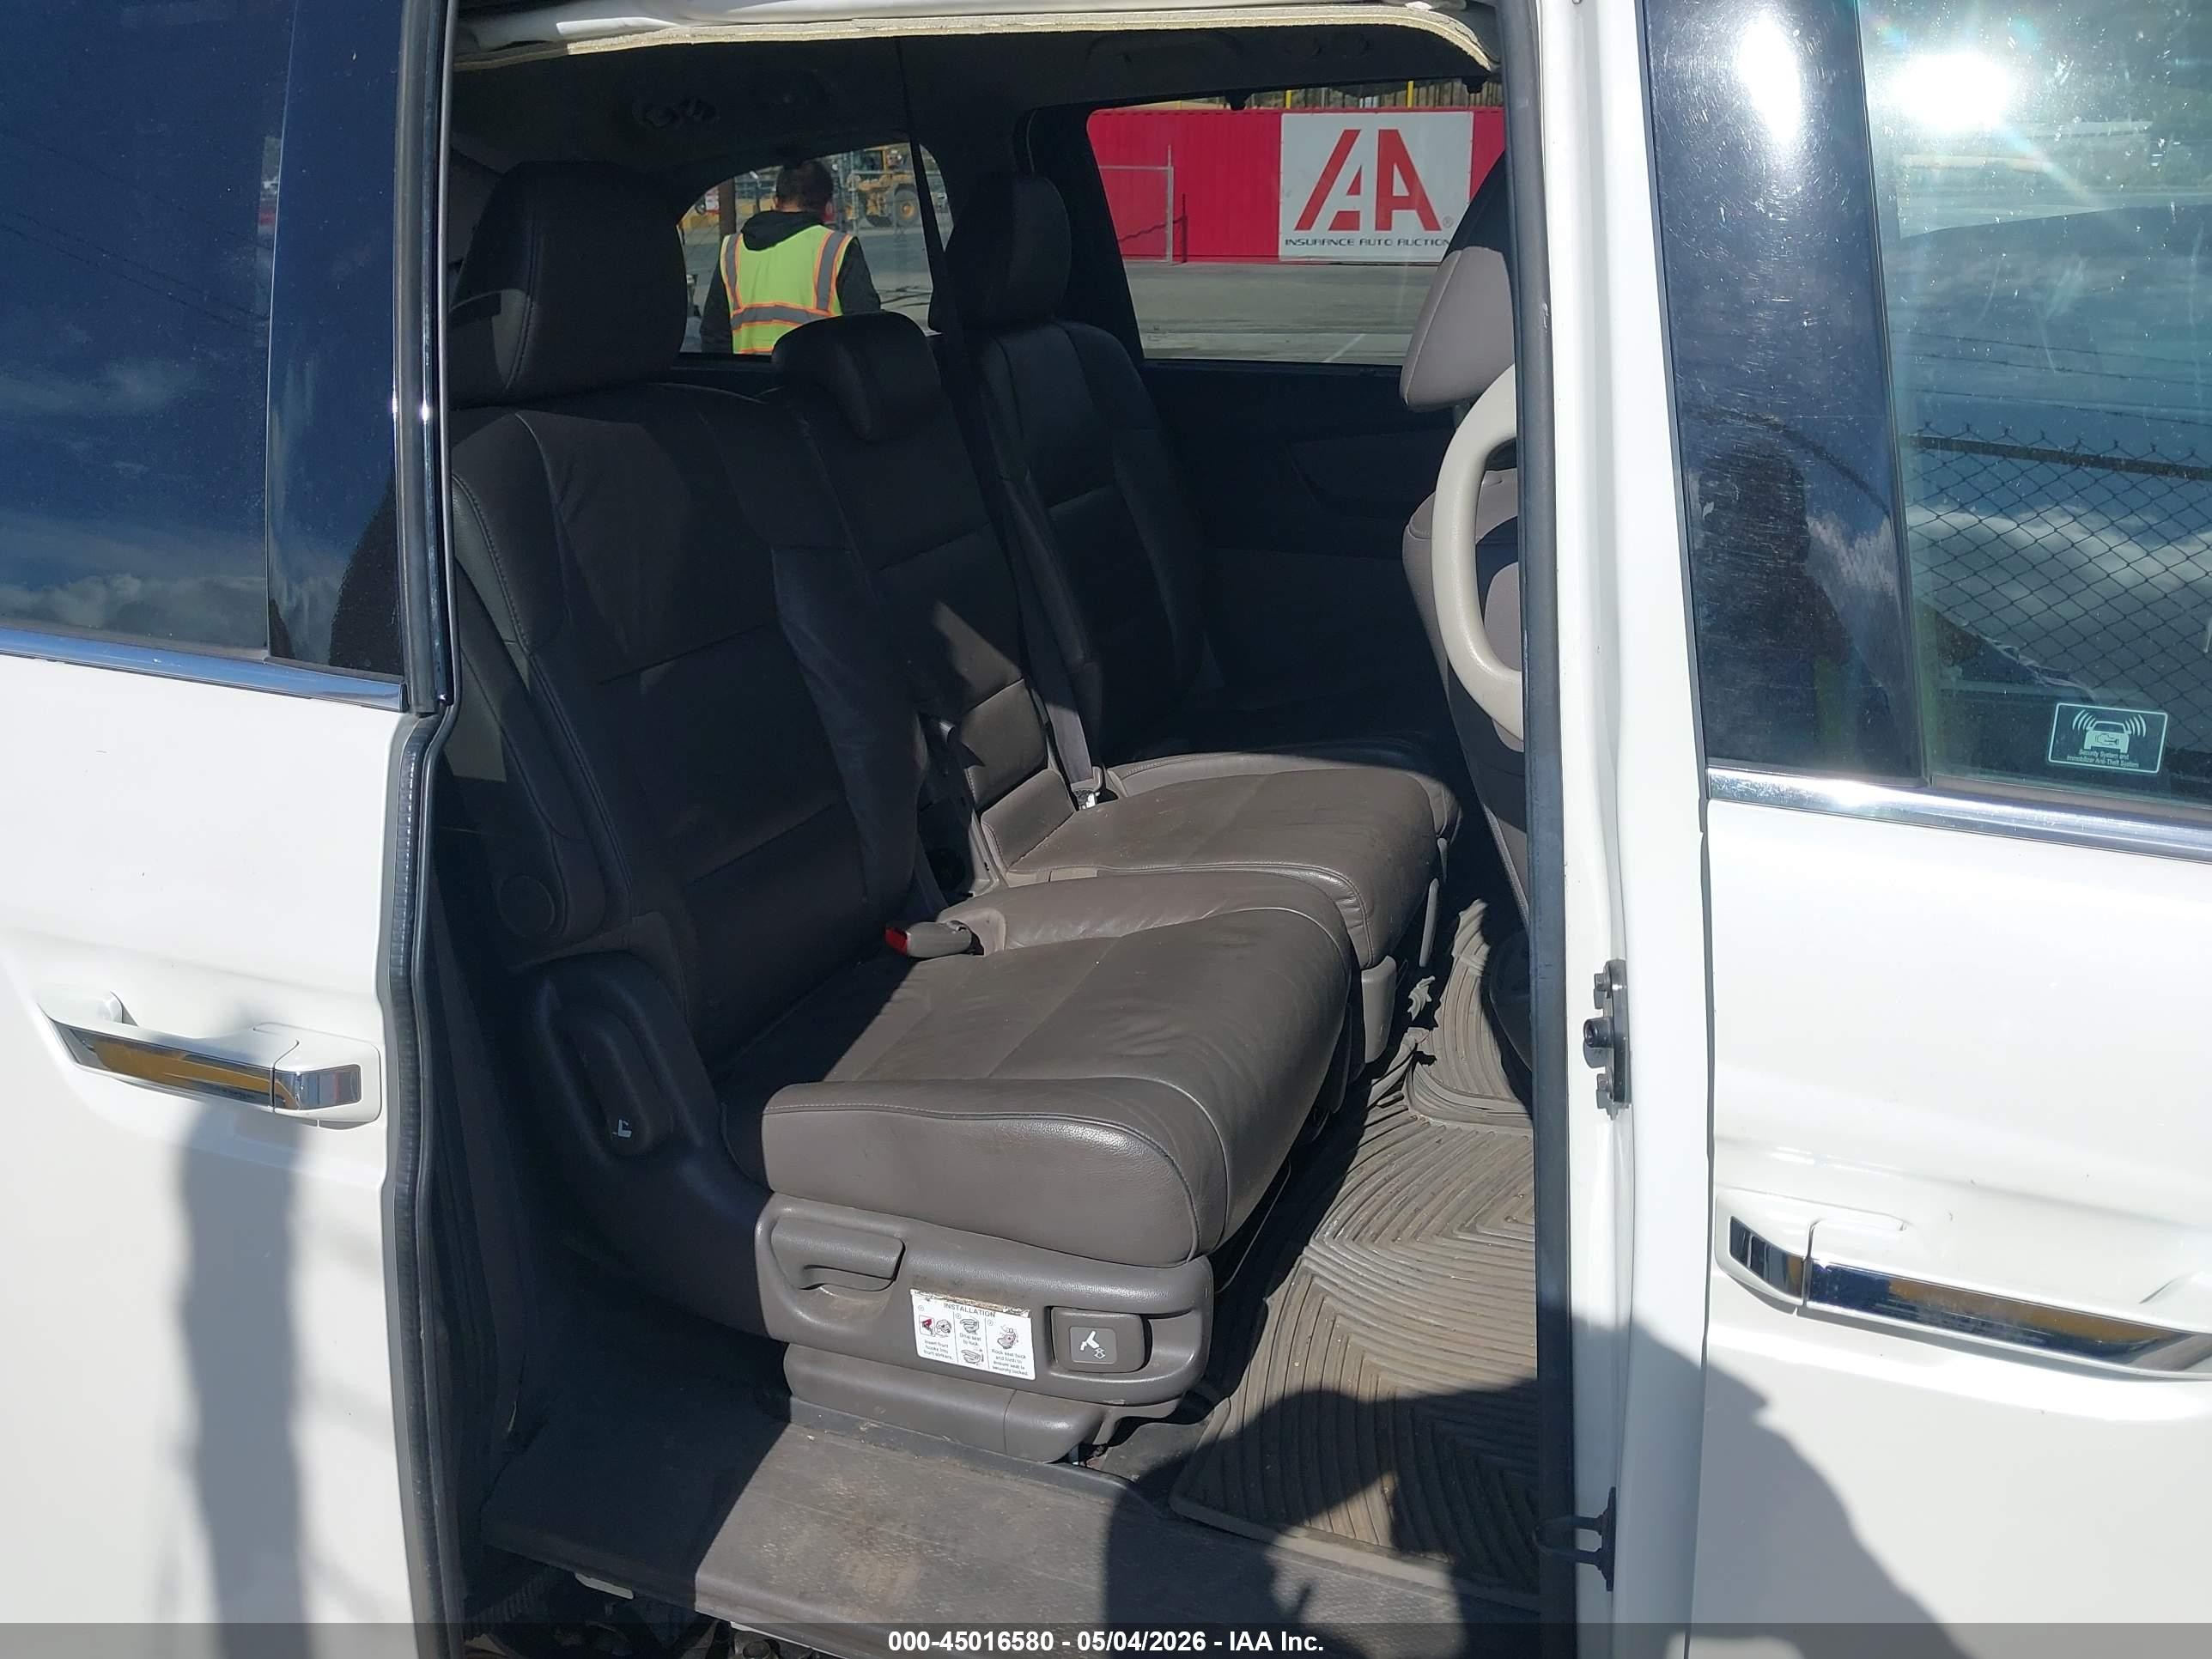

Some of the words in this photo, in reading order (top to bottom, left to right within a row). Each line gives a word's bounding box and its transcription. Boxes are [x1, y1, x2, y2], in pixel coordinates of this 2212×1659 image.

[1285, 238, 1354, 246] INSURANCE
[1359, 238, 1391, 246] AUTO
[945, 1303, 995, 1317] INSTALLATION
